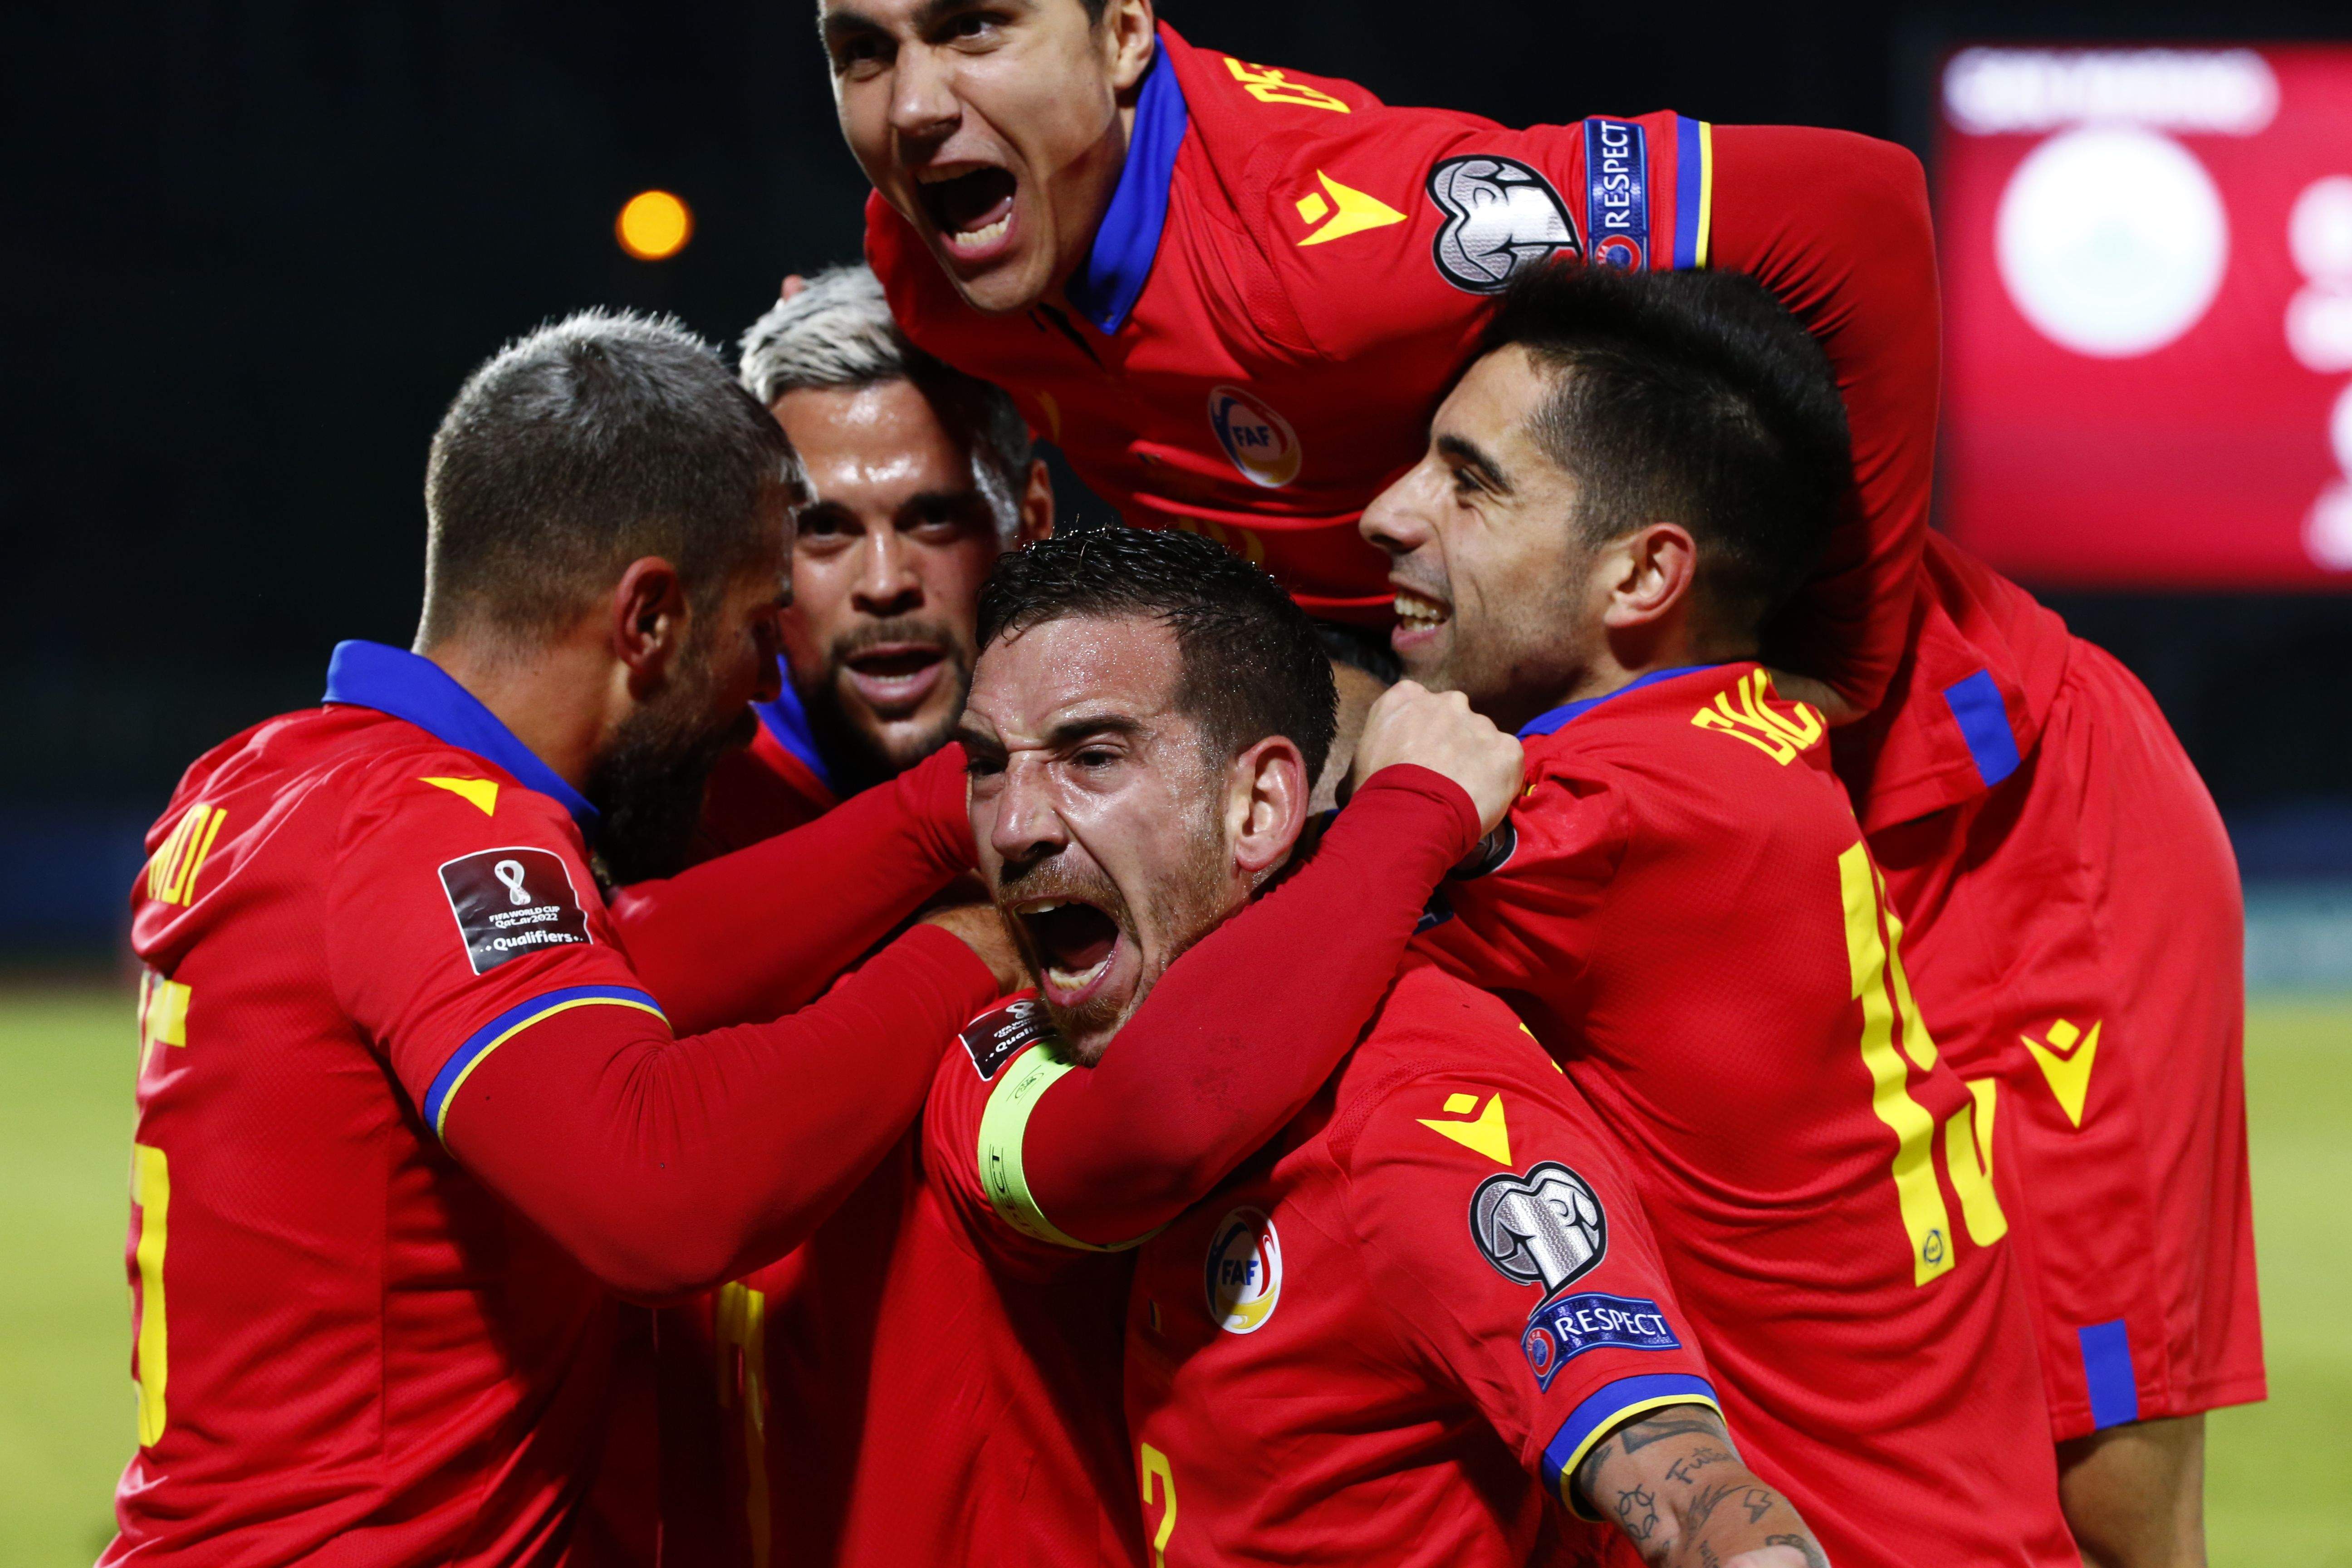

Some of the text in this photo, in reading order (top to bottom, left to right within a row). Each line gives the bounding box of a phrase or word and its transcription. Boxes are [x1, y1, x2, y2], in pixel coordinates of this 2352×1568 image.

[1601, 120, 1630, 228] RESPECT
[1232, 425, 1269, 447] FAF
[489, 906, 560, 922] FIFA WORLD CUP
[493, 930, 573, 951] Qualifiers
[1221, 1259, 1259, 1286] FAF
[1555, 1308, 1667, 1342] RESPECT
